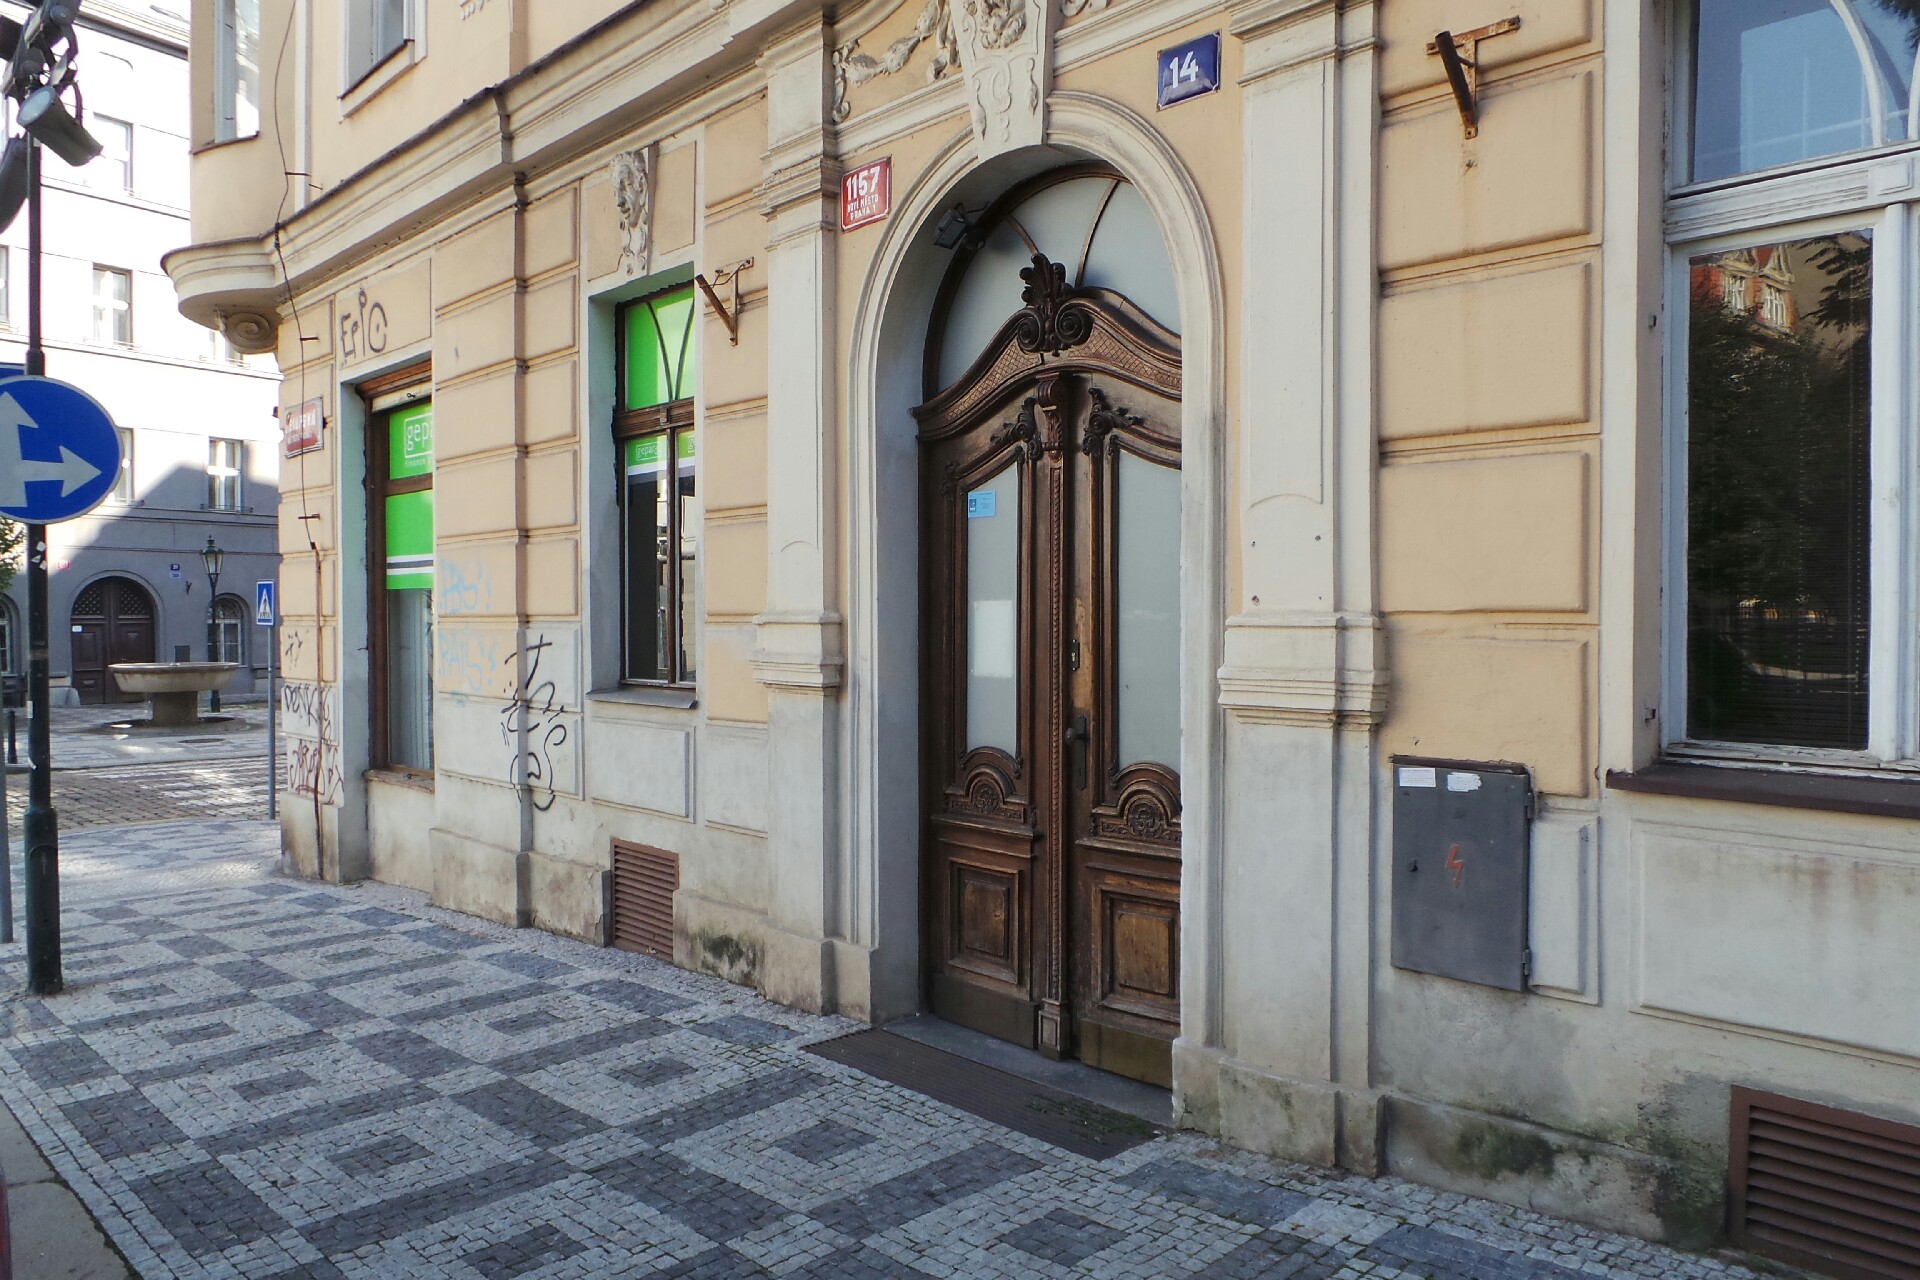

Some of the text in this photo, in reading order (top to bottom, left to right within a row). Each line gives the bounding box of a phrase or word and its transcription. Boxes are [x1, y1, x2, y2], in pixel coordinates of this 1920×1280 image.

[1169, 51, 1199, 89] 14
[846, 166, 880, 201] 1157
[850, 203, 876, 220] PRAHA 1
